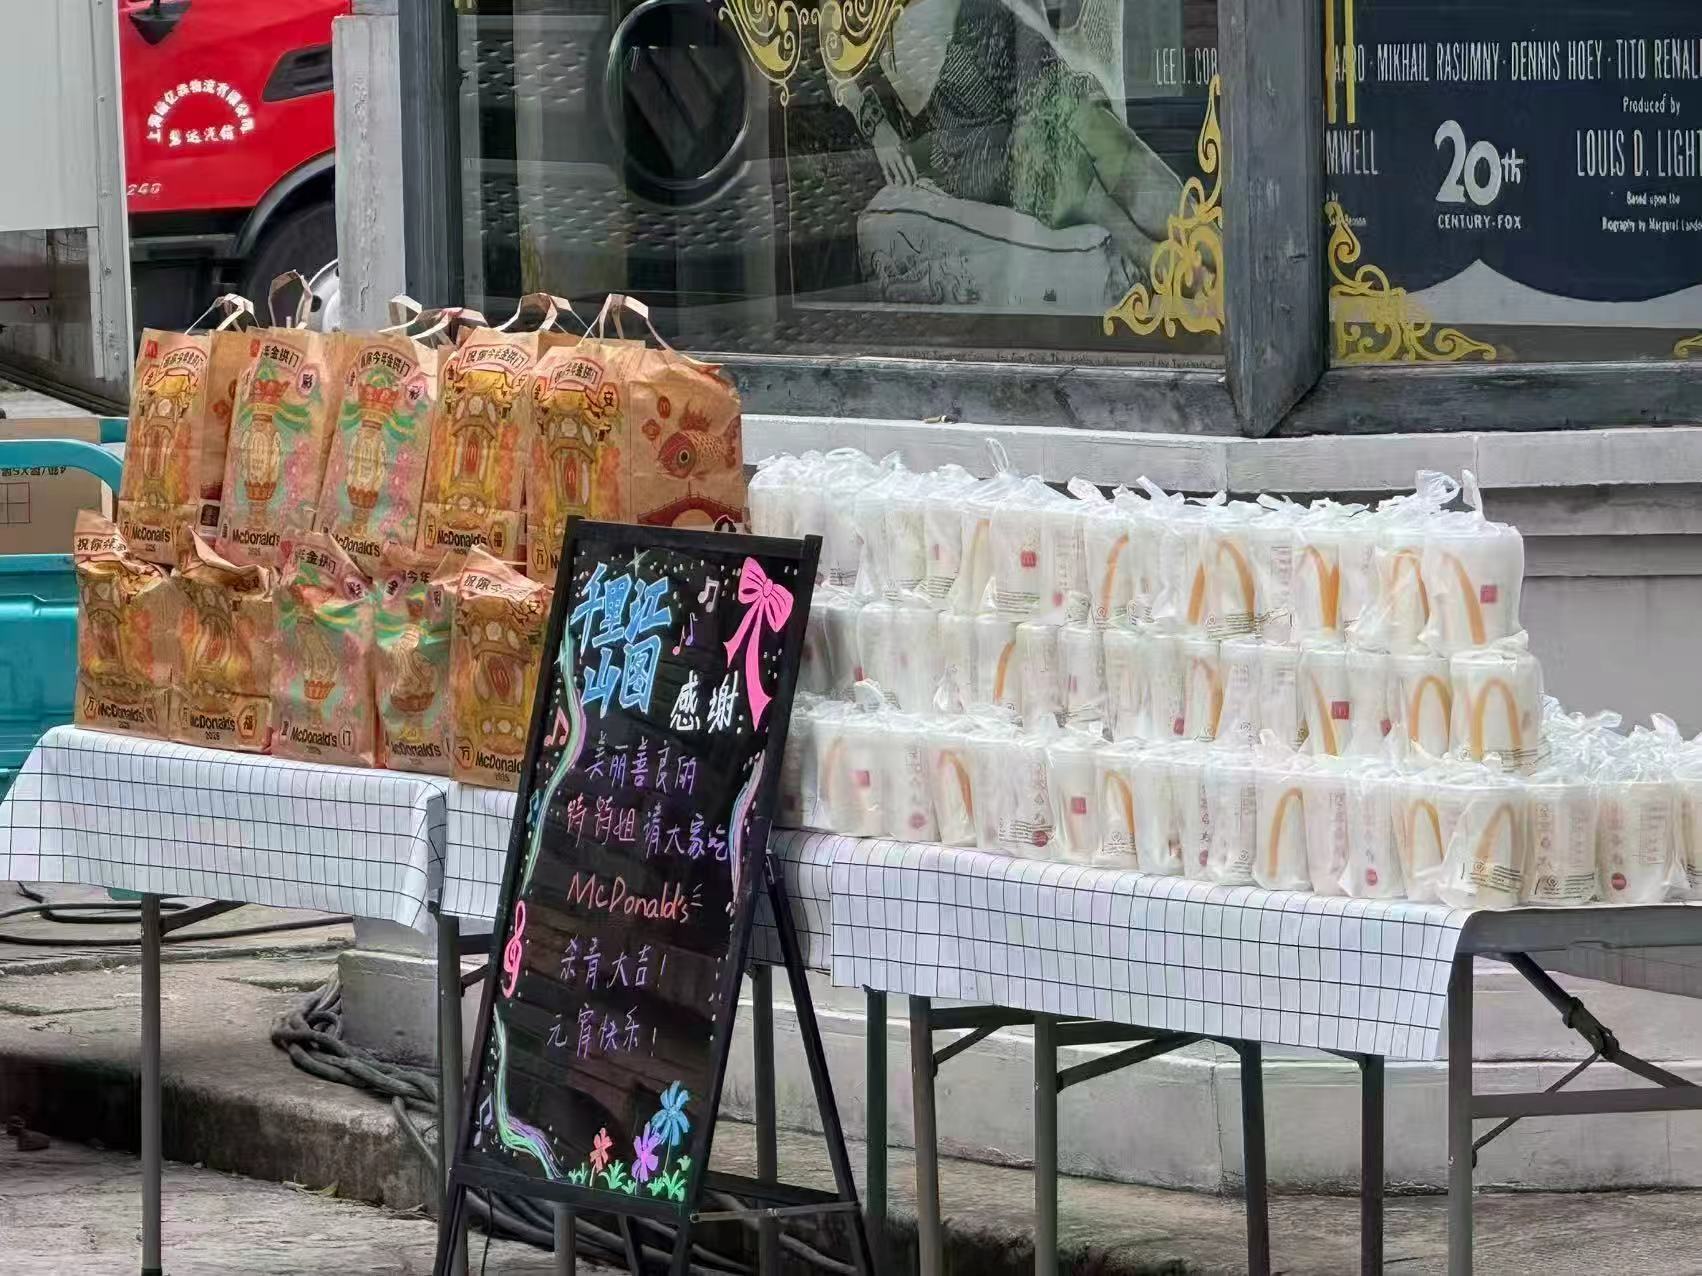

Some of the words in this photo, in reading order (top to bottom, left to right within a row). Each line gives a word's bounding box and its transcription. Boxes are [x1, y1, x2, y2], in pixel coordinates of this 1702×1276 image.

[1155, 47, 1176, 85] LEE
[1377, 43, 1429, 81] MIKHAIL
[1436, 42, 1499, 81] RASUMNY
[1511, 41, 1560, 81] DENNIS
[1567, 39, 1602, 80] HOEY
[1616, 38, 1646, 79] TITO
[1654, 38, 1702, 79] RENAL
[1623, 93, 1666, 113] Produced
[1670, 97, 1681, 116] by
[1434, 119, 1524, 206] 20th
[1576, 128, 1625, 177] LOUIS
[1633, 128, 1649, 177] D.
[568, 561, 673, 658] 千里江
[580, 633, 662, 720] 山图
[566, 871, 690, 925] McDonald's
